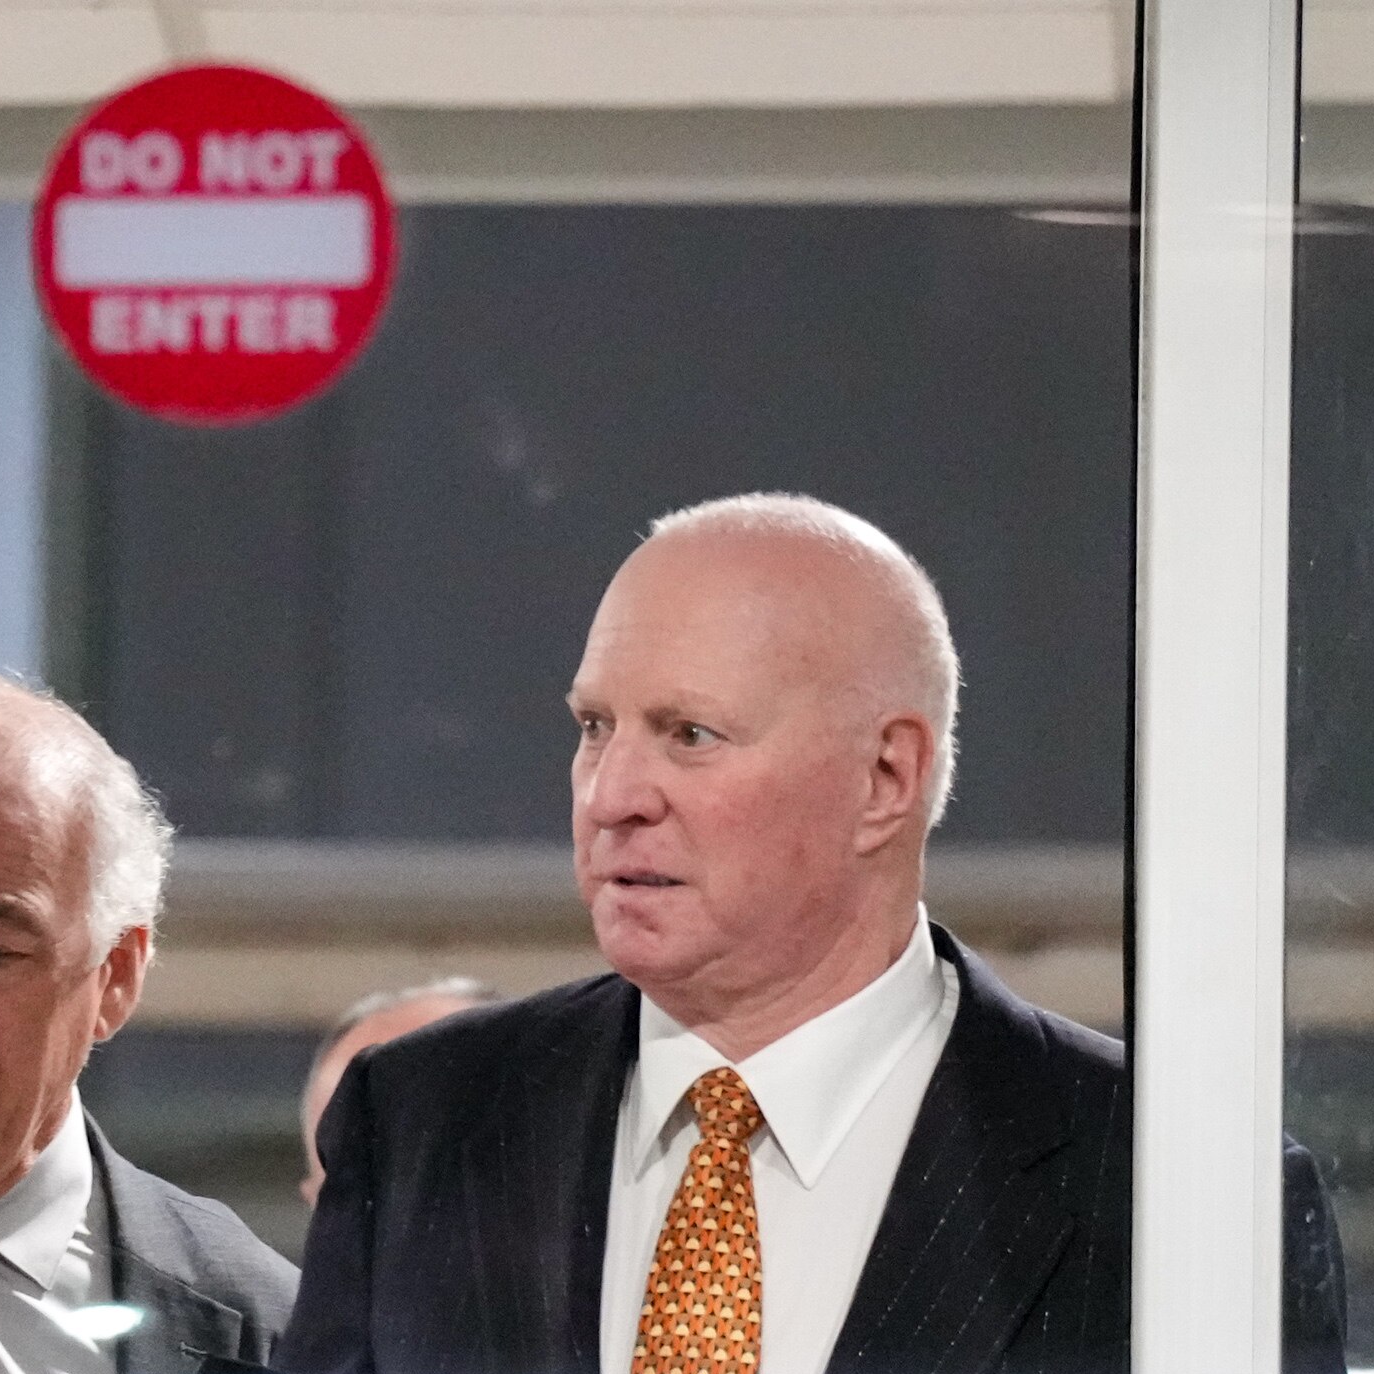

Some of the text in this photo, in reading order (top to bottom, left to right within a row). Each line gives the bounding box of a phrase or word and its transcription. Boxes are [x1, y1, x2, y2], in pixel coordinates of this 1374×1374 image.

[79, 129, 351, 194] DO NOT
[89, 295, 337, 354] ENTER
